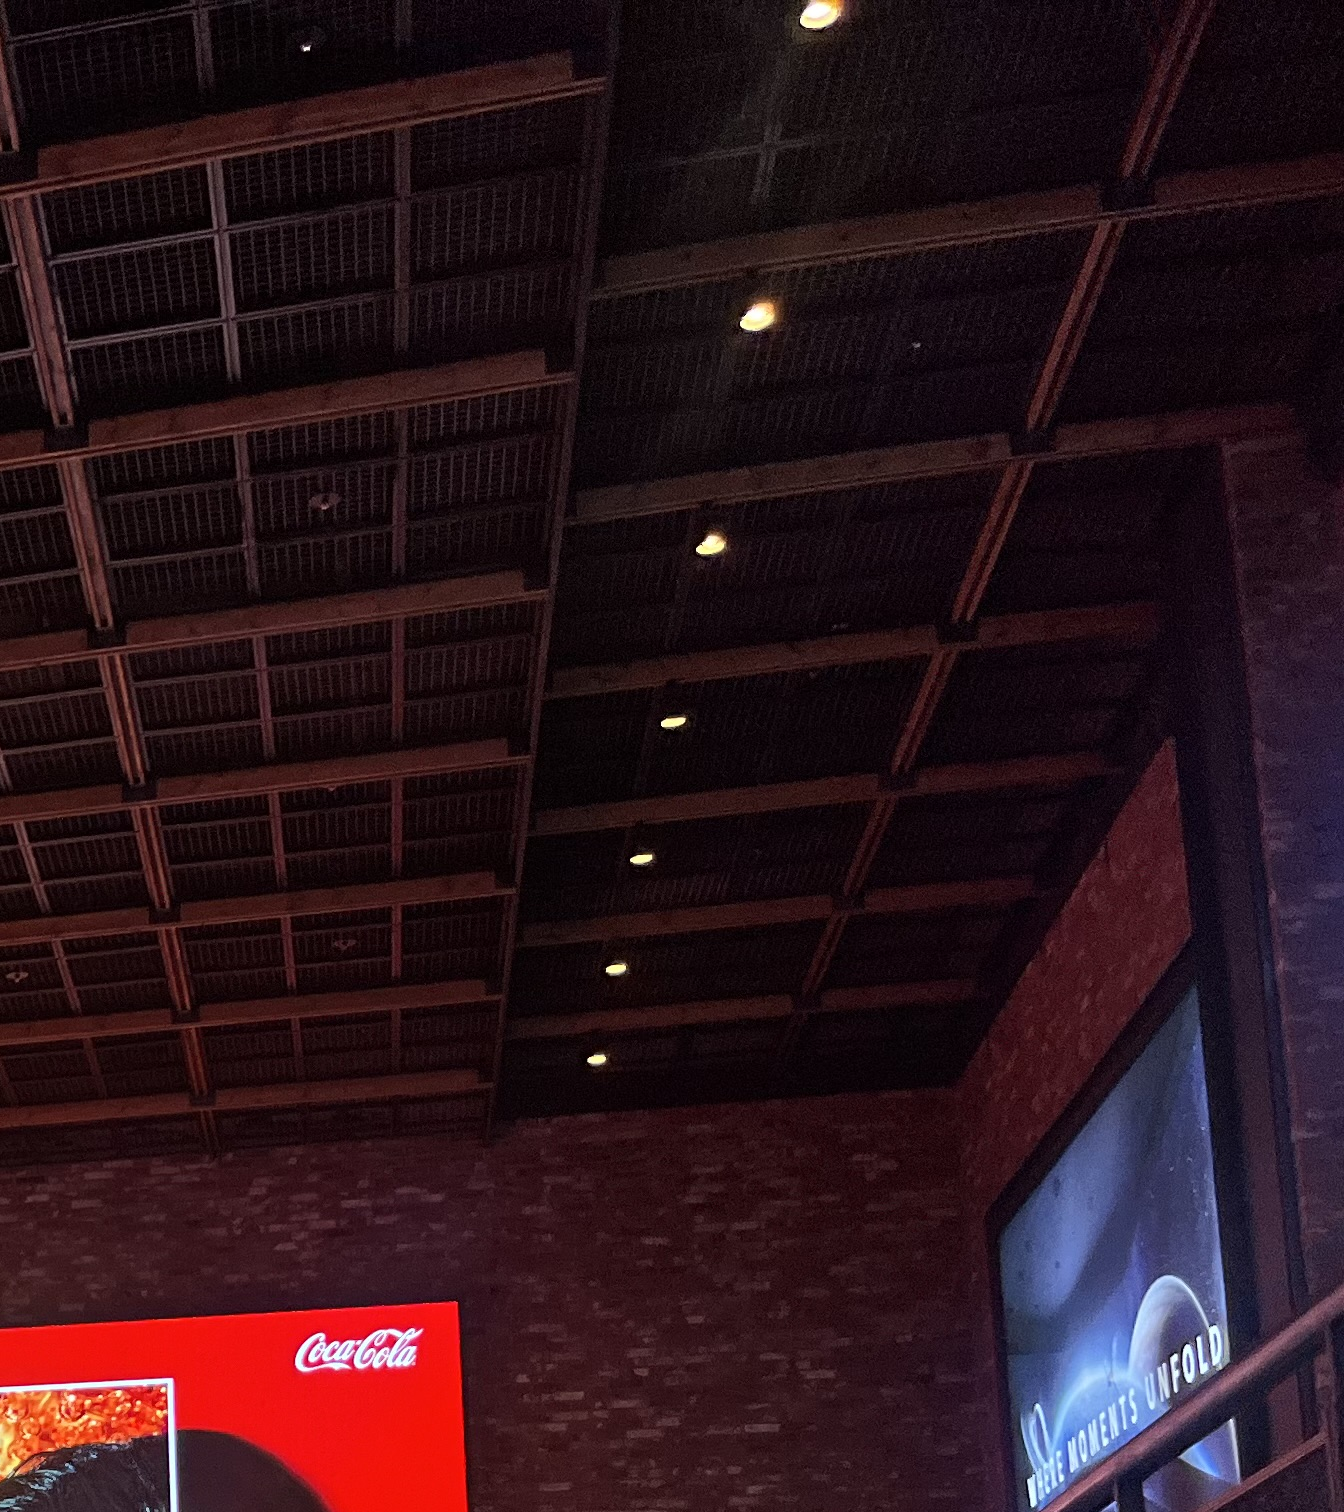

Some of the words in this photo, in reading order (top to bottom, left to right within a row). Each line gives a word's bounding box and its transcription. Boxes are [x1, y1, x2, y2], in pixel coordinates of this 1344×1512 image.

[294, 1327, 423, 1373] Coca-Cola
[1026, 1450, 1065, 1508] WHERE
[1067, 1387, 1138, 1473] MOMENTS
[1144, 1324, 1223, 1411] UNFOLD
